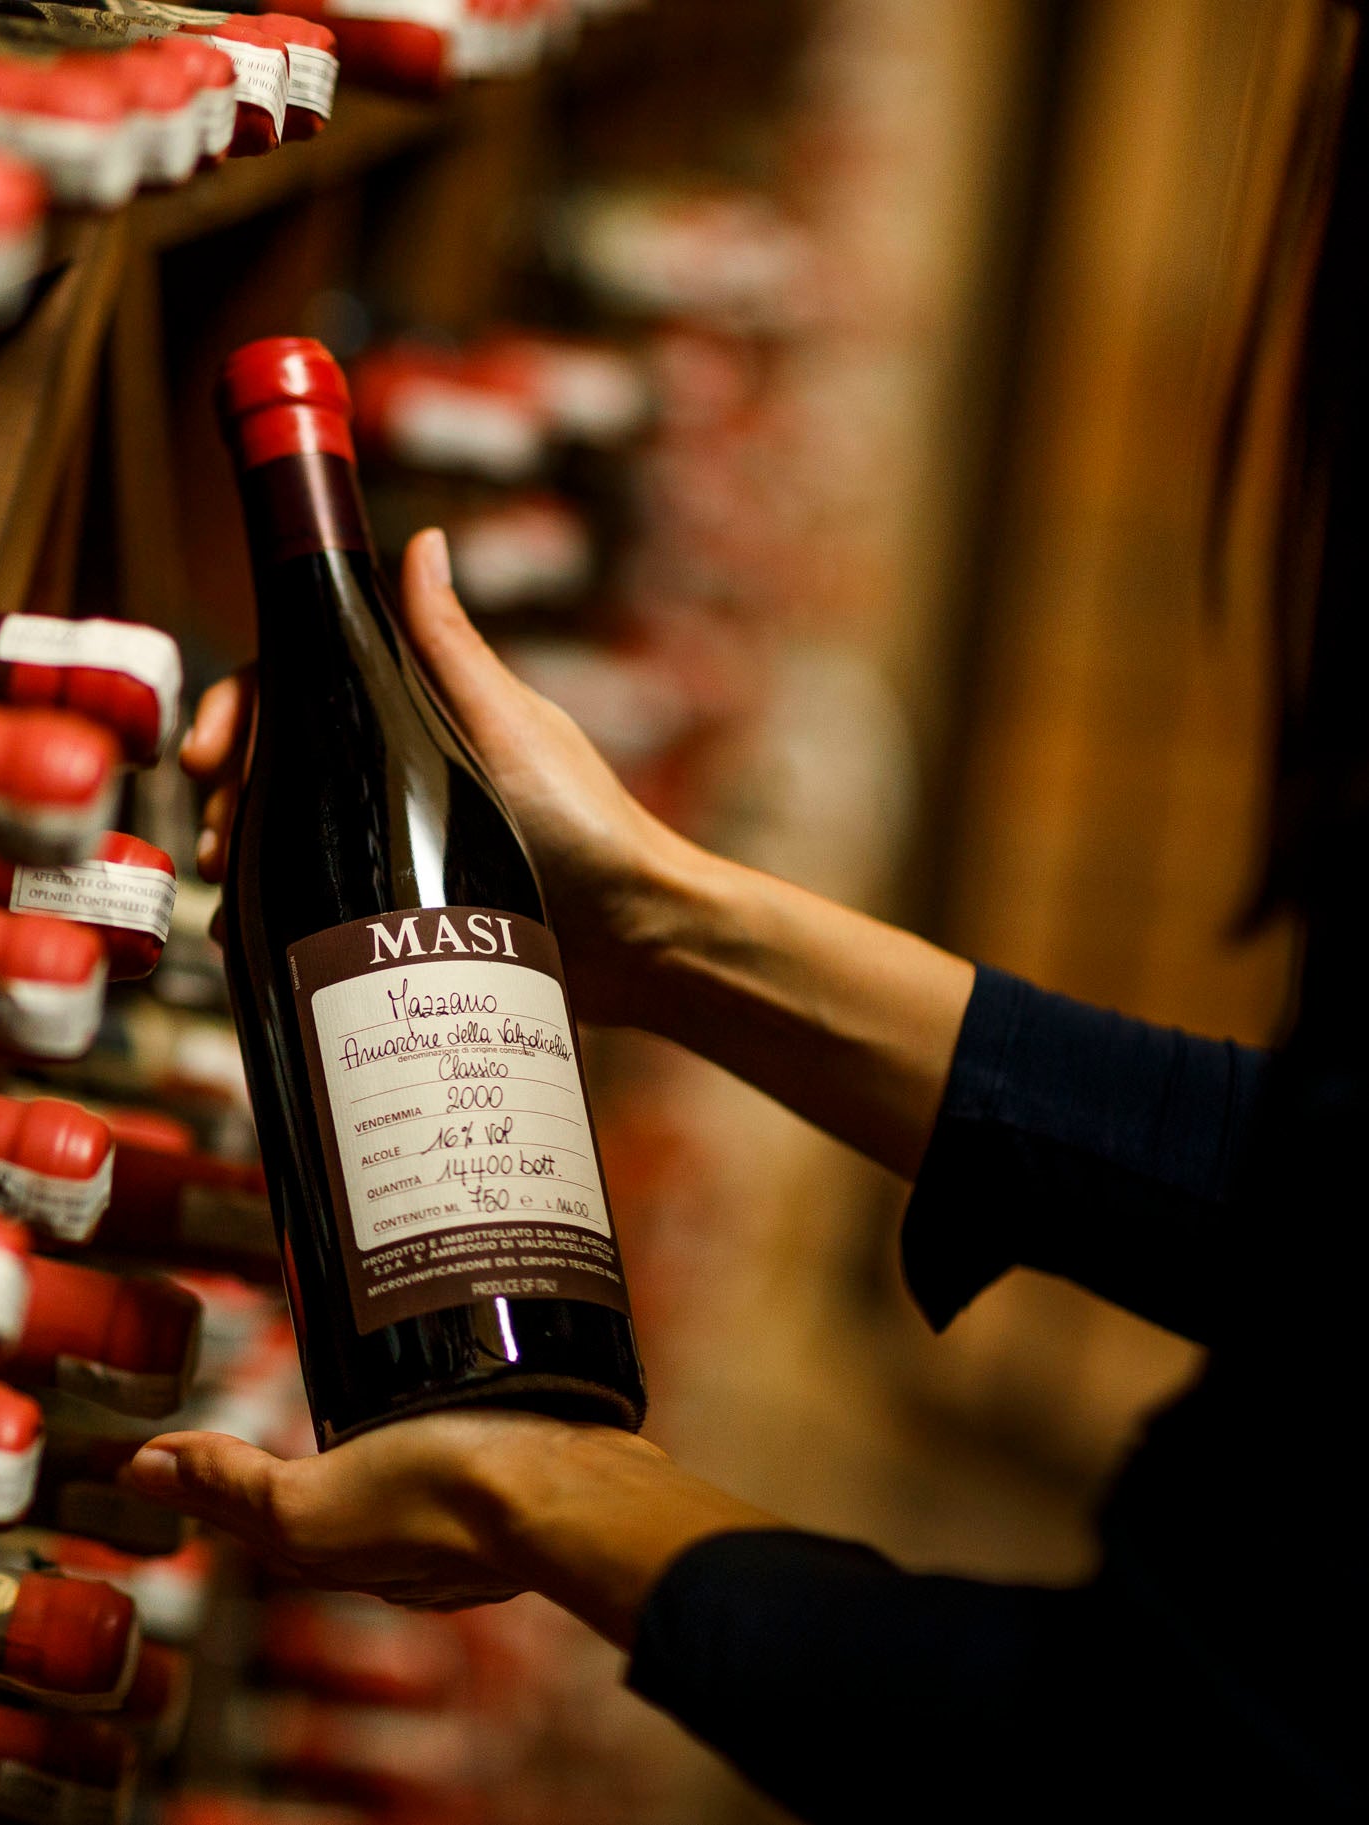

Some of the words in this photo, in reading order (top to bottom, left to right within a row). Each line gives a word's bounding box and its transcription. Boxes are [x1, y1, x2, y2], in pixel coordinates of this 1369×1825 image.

[366, 914, 519, 964] MASI
[388, 978, 497, 1035] Mazzano
[339, 1032, 442, 1070] Amarone
[447, 1021, 492, 1044] della
[397, 1047, 459, 1063] denominazione
[461, 1046, 470, 1054] di
[471, 1046, 498, 1056] origine
[500, 1047, 535, 1058] controllata
[438, 1054, 509, 1081] Classico
[354, 1107, 423, 1133] VENDEMMIA
[447, 1086, 503, 1114] 2000
[361, 1147, 401, 1167] ALCOLE
[420, 1121, 474, 1155] 16%
[437, 1155, 513, 1186] 14400
[373, 1207, 441, 1233] CONTENUTO
[445, 1203, 460, 1214] ML
[468, 1185, 510, 1213] 750
[362, 1241, 426, 1269] PRODOTTO
[429, 1238, 437, 1248] E
[440, 1228, 533, 1246] IMBOTTIGLIATO
[536, 1229, 553, 1238] DA
[555, 1230, 579, 1242] MASI
[429, 1240, 498, 1260] AMBROGIO
[500, 1239, 514, 1249] DI
[516, 1239, 591, 1255] VALPOLICELLA
[367, 1258, 491, 1298] MICROVINIFICAZIONE
[494, 1257, 519, 1267] DEL
[520, 1256, 566, 1267] GRUPPO
